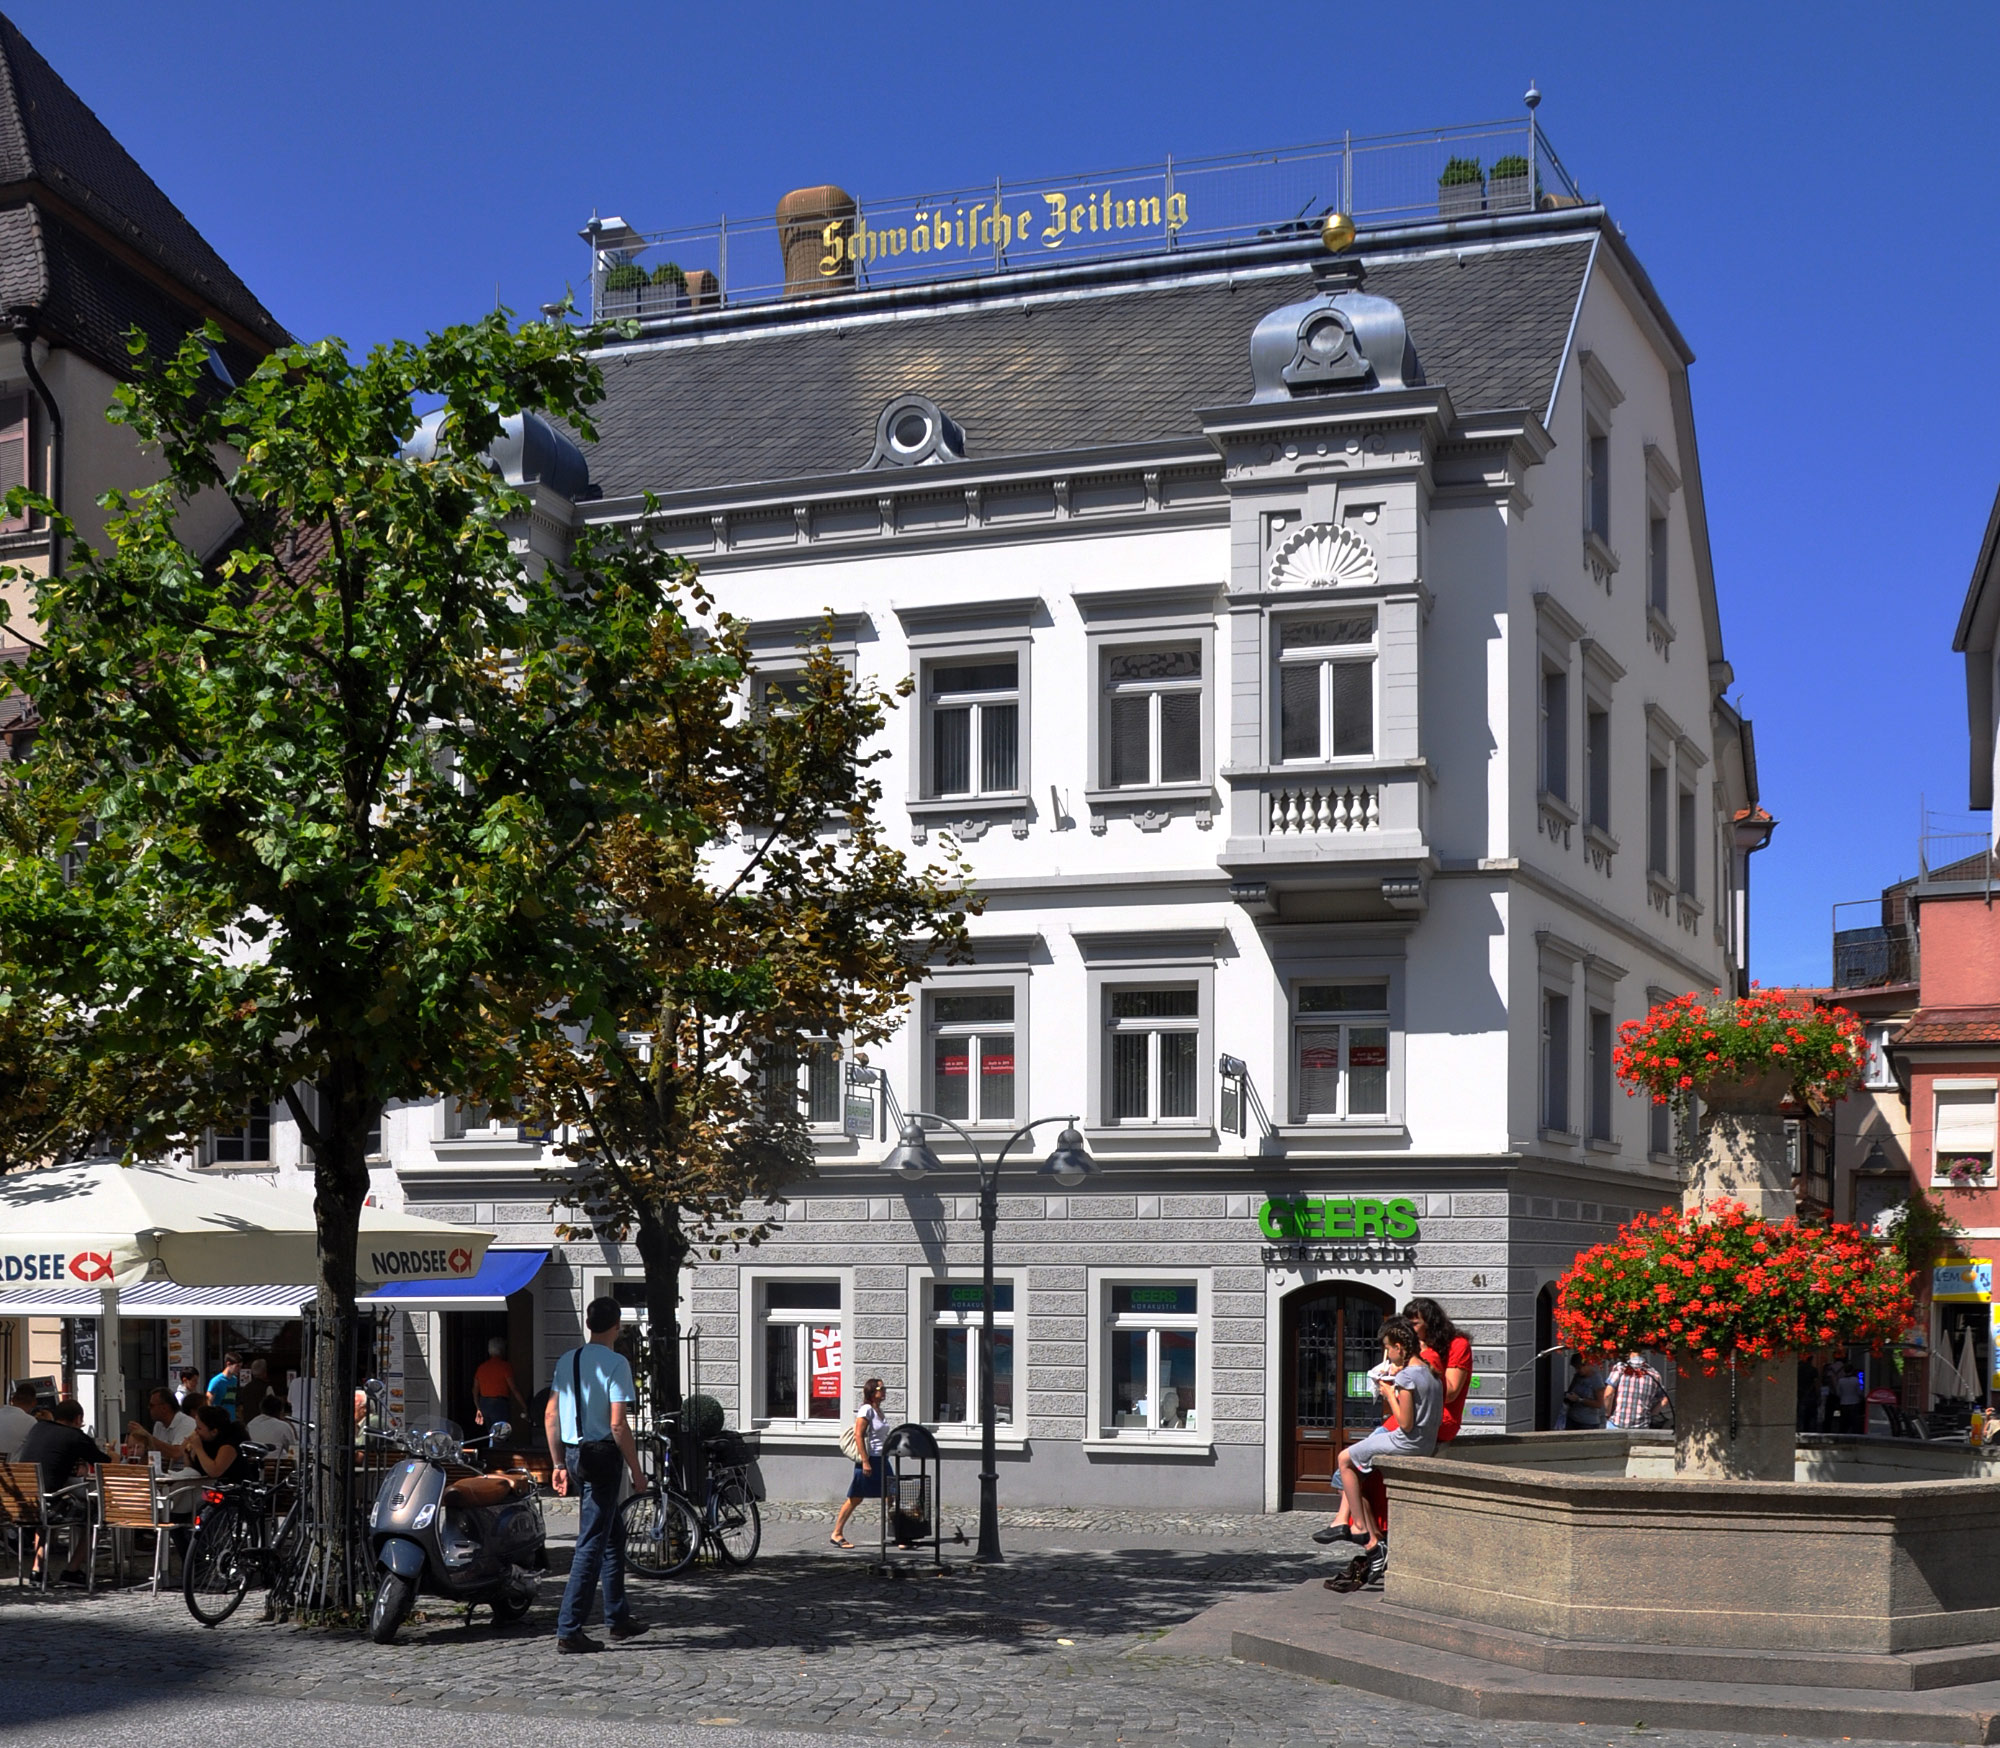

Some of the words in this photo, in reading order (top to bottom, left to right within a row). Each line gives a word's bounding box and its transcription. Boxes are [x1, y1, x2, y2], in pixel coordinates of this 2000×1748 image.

[1042, 190, 1189, 248] Zeitung
[1259, 1198, 1418, 1239] GEERS
[0, 1254, 64, 1282] DSEE
[371, 1250, 447, 1275] NORDSEE
[1472, 1274, 1488, 1287] 41
[1131, 1290, 1177, 1303] GEERS
